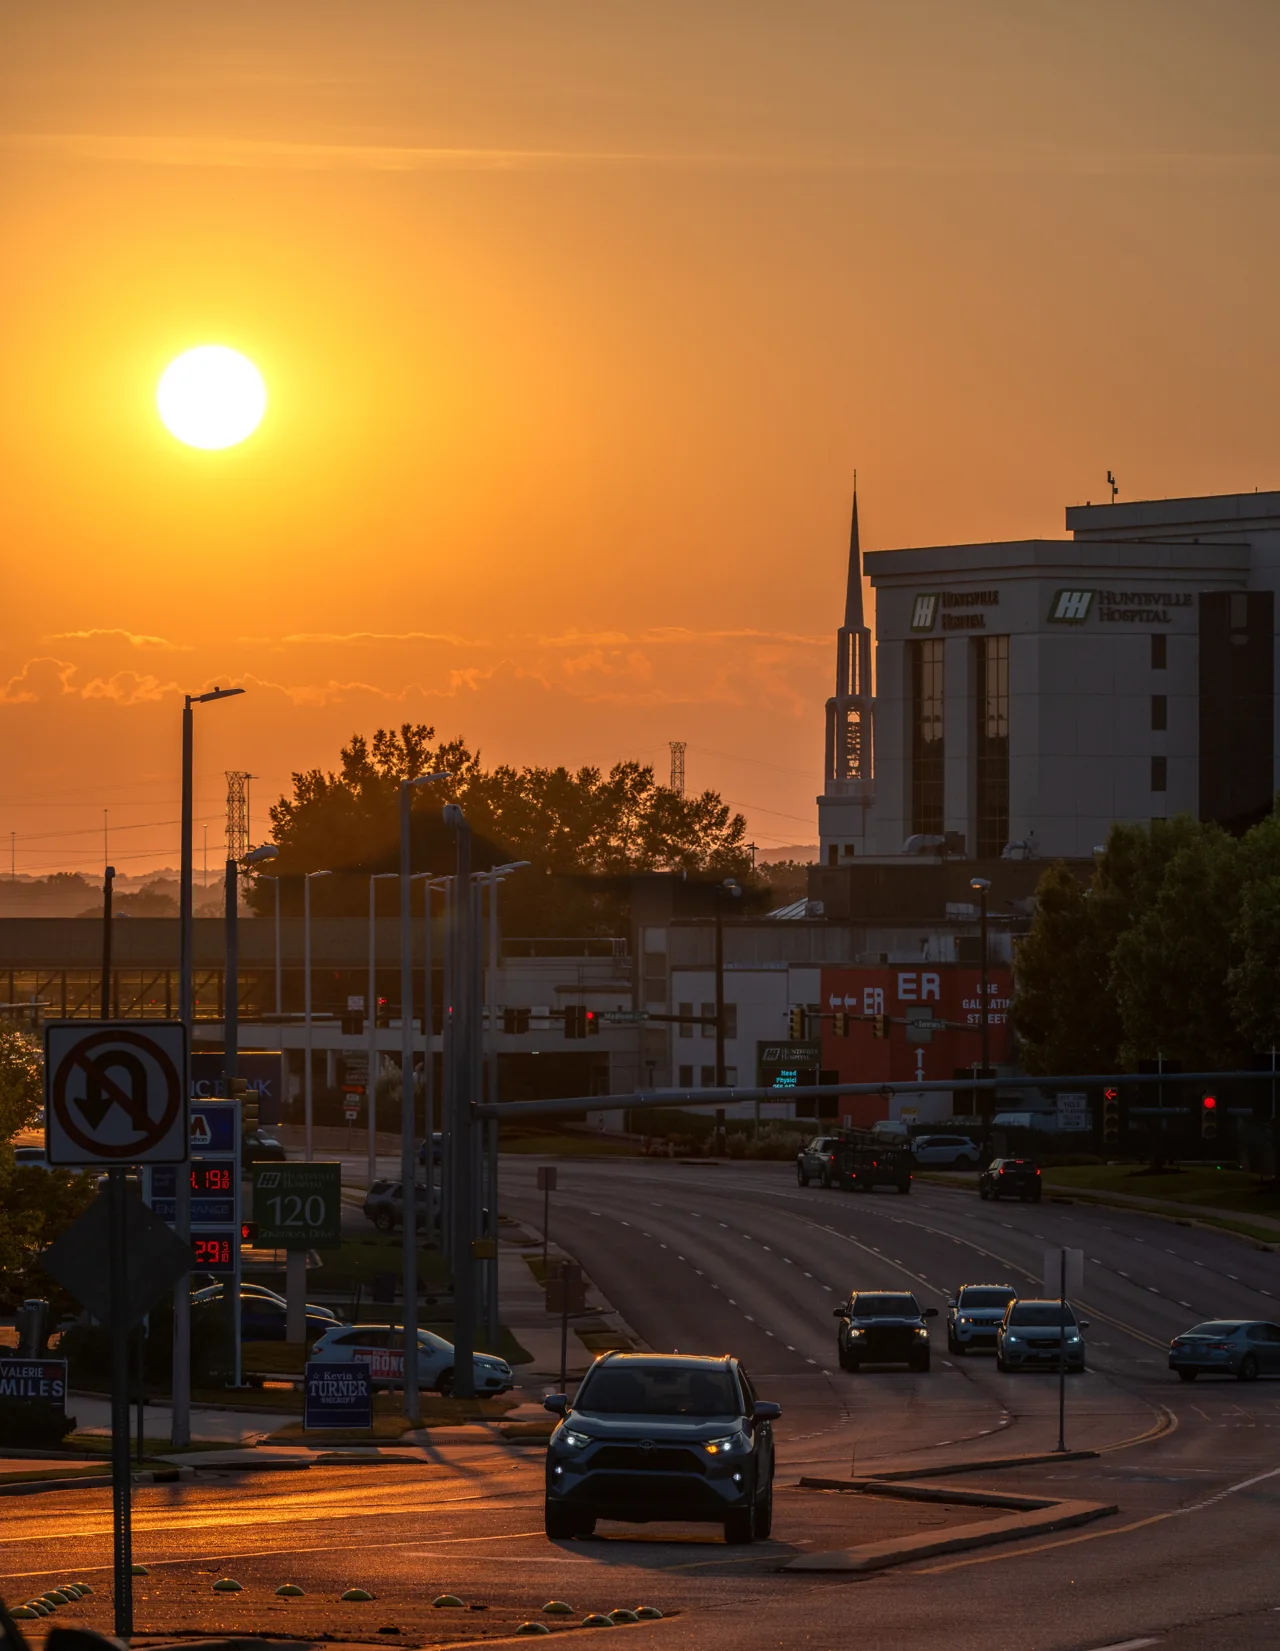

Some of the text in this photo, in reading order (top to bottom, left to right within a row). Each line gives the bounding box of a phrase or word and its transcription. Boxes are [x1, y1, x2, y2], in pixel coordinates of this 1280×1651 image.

[1098, 590, 1192, 606] HUNTSVILLE
[1098, 609, 1171, 622] HOSPITAL
[897, 972, 940, 1000] ER
[863, 987, 884, 1015] ER
[967, 1013, 1008, 1024] STEET
[266, 1195, 326, 1227] 120
[258, 1229, 335, 1239] Governors Drive
[0, 1366, 44, 1378] VALERIE
[324, 1371, 353, 1380] Kevin
[0, 1379, 64, 1397] MILES
[309, 1380, 368, 1397] TURNER
